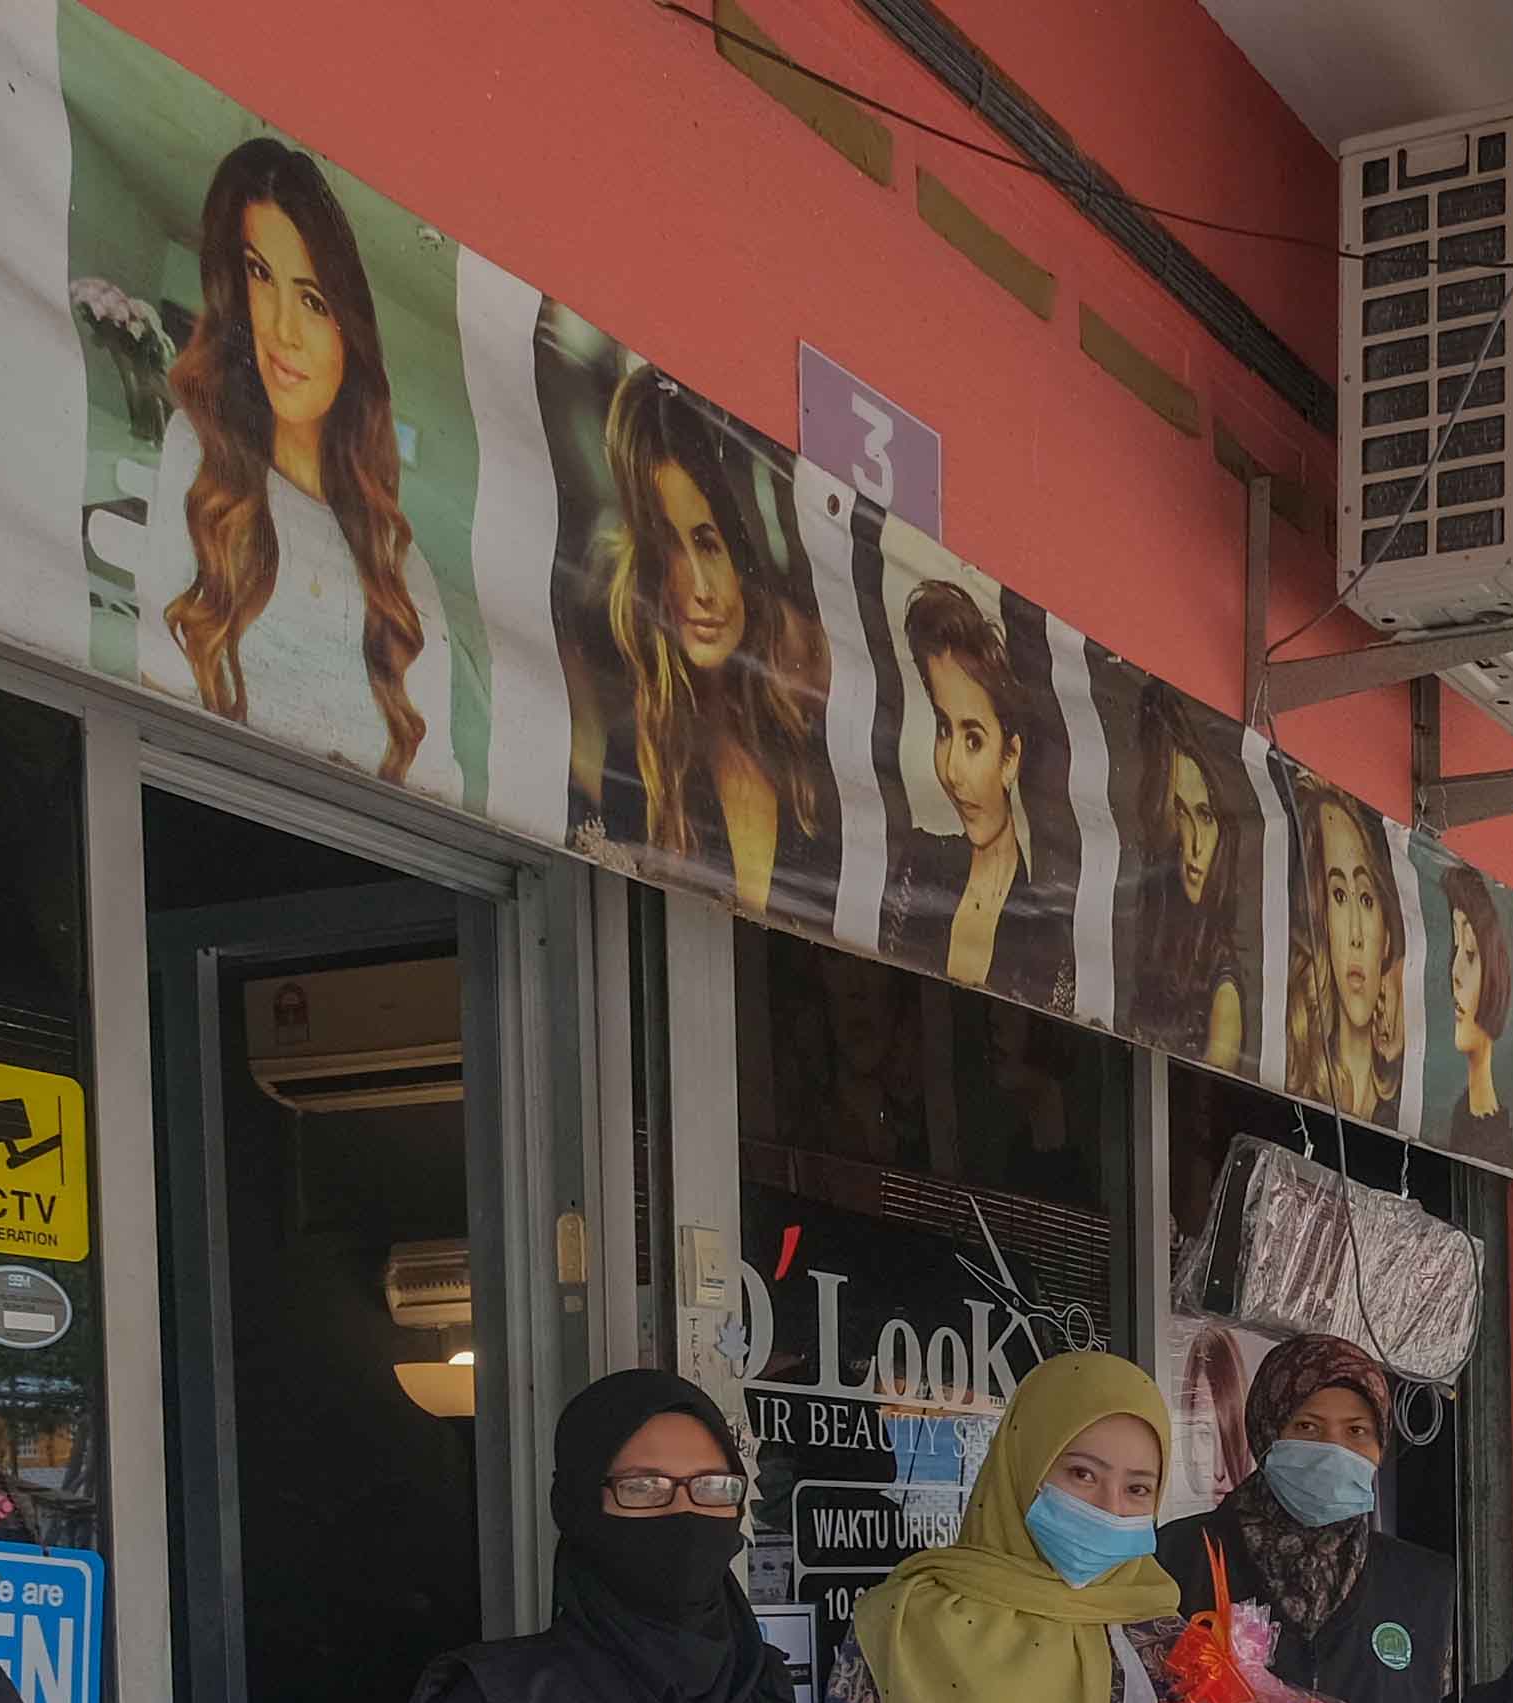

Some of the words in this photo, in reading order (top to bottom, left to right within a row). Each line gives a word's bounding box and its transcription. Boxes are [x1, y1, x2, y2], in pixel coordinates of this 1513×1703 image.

[851, 391, 894, 508] 3
[806, 1401, 945, 1457] BEAUTY
[812, 1509, 888, 1549] WAKTU
[22, 1583, 64, 1607] are
